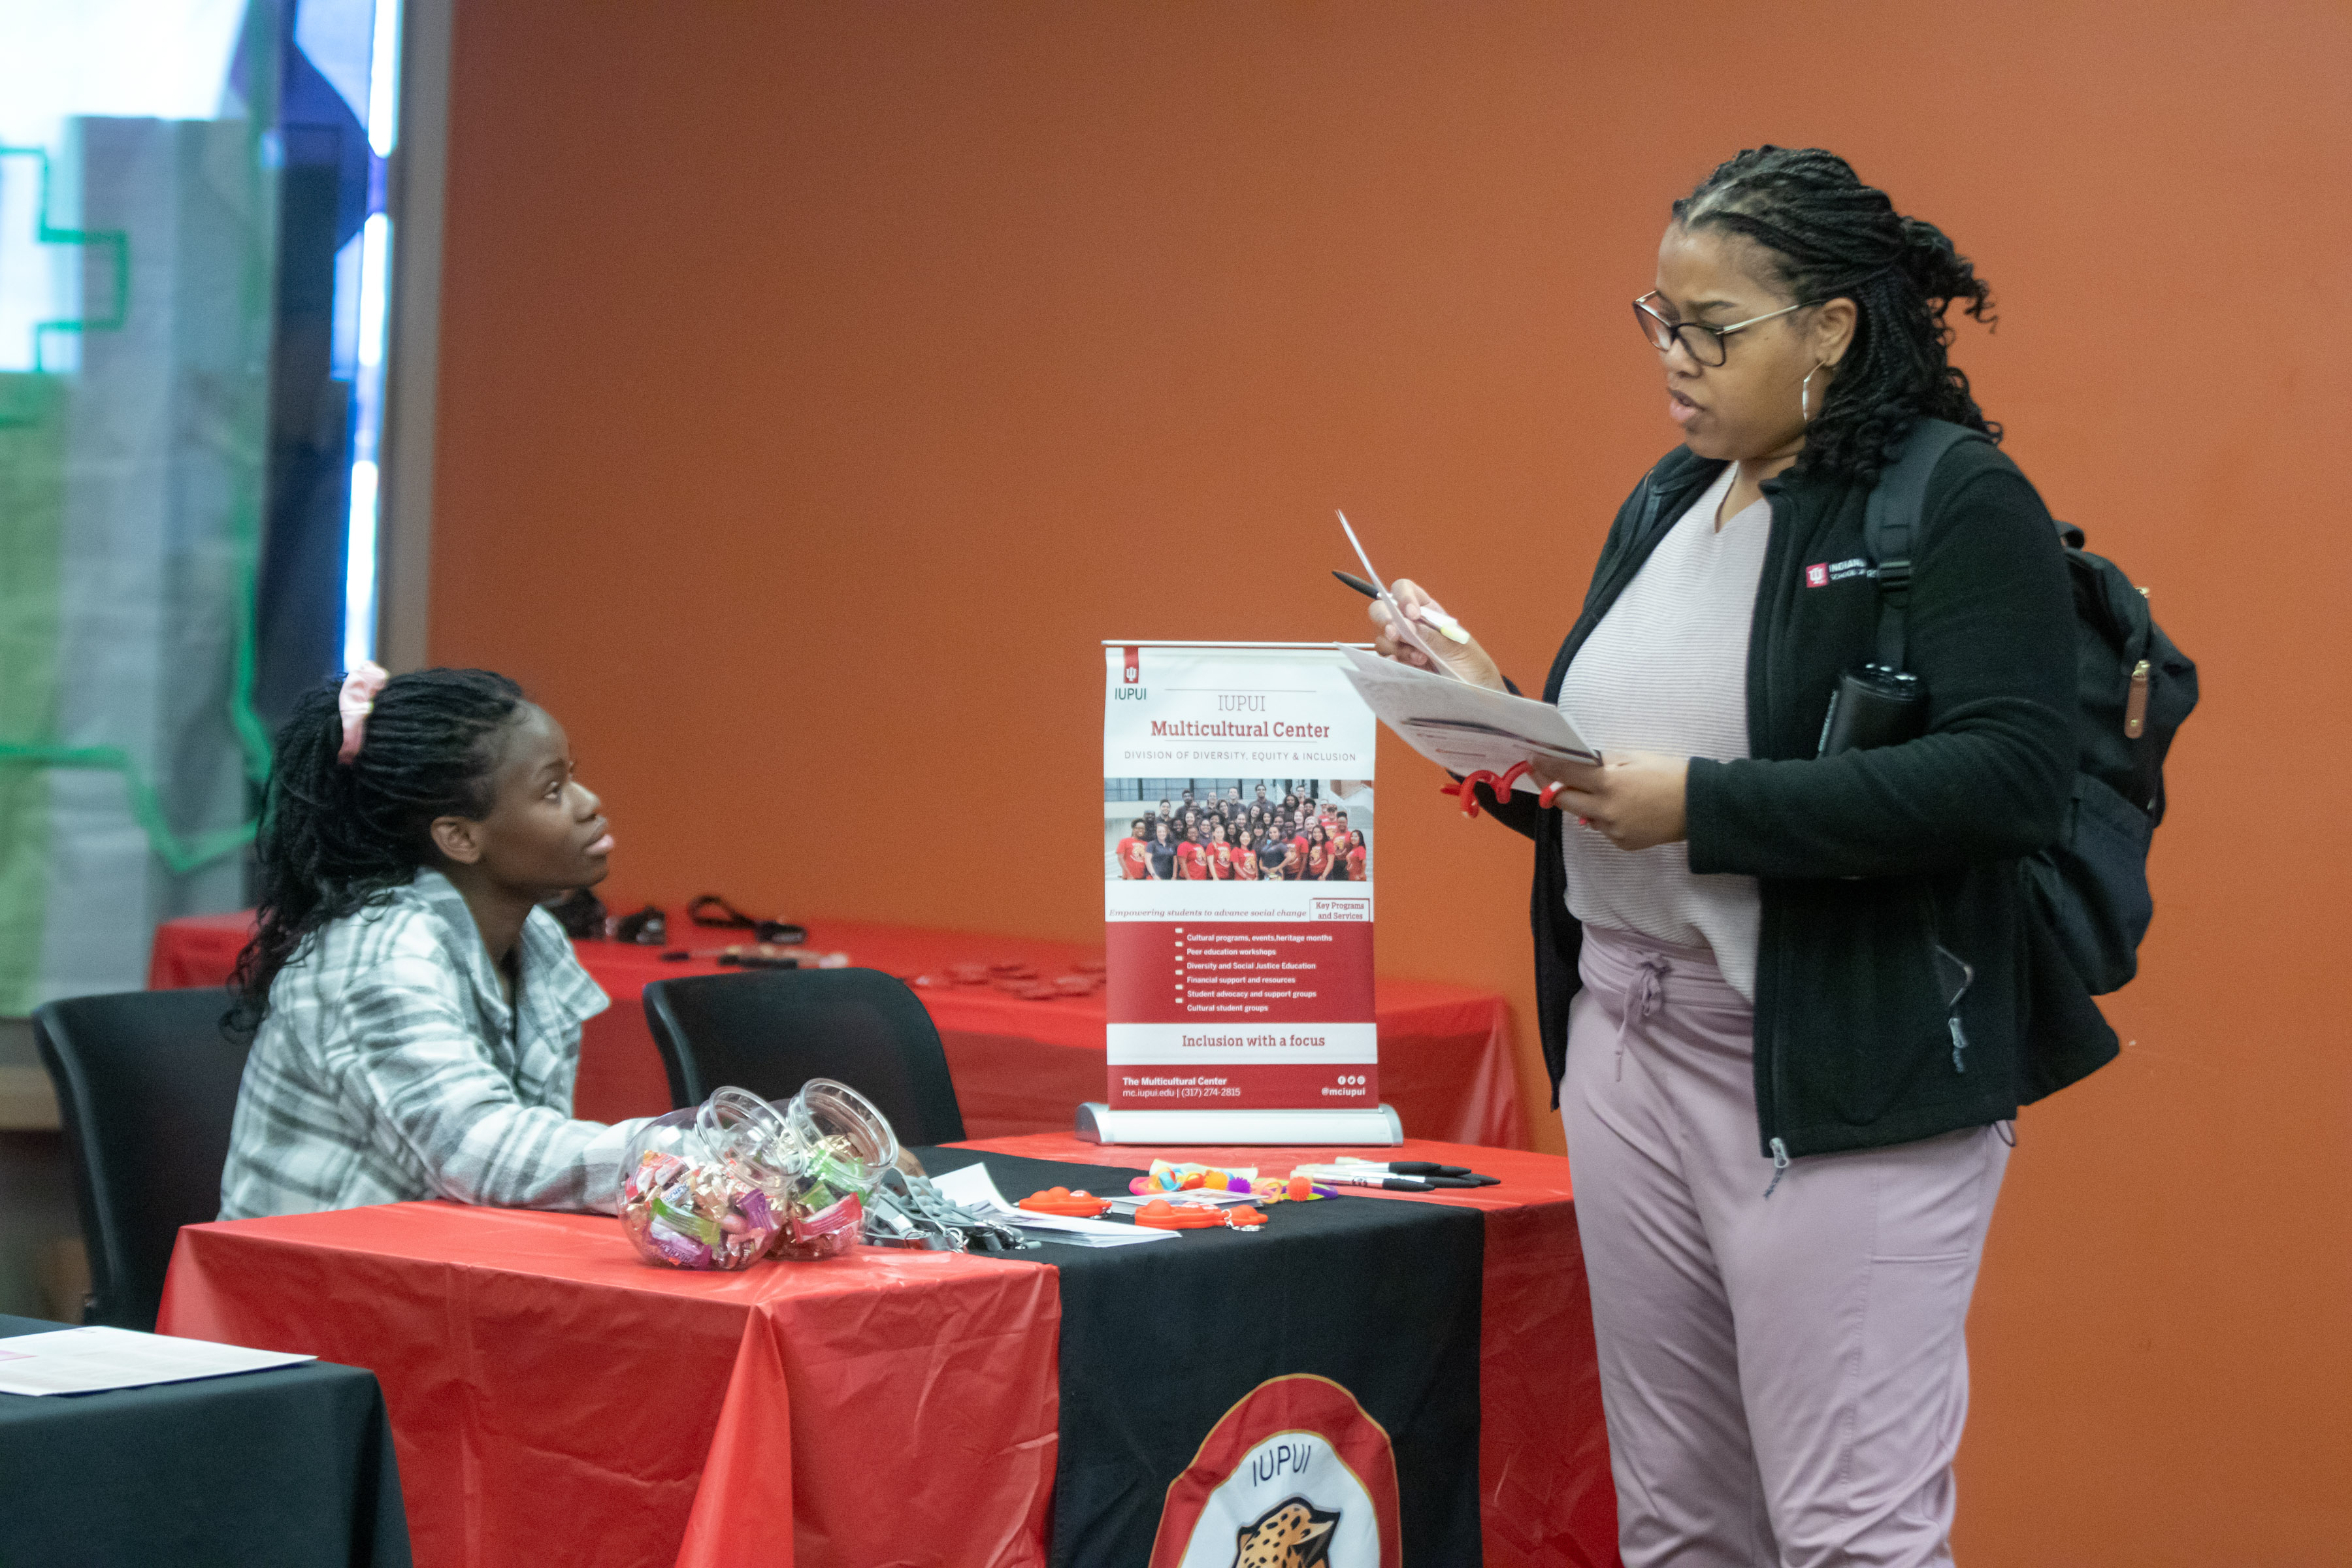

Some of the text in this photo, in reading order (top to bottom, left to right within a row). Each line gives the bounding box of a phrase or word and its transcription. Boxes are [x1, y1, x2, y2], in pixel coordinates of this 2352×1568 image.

[1115, 687, 1147, 700] IUPUI
[1218, 694, 1266, 711] IUPUI
[1151, 720, 1330, 738] Multicultural Center
[1124, 751, 1172, 759] DIVISION
[1193, 751, 1249, 760] DIVERSITY,
[1252, 752, 1289, 761] EQUITY
[1303, 753, 1356, 761] INCLUSION
[1316, 902, 1364, 911] Key Programs
[1109, 909, 1166, 917] Empowering
[1277, 909, 1307, 917] change
[1318, 911, 1332, 920] and
[1239, 948, 1276, 956] workshops
[1181, 1034, 1326, 1047] Inclusion with a focus
[1122, 1077, 1139, 1086] The
[1141, 1077, 1196, 1086] Multicultural
[1122, 1089, 1175, 1098] mc.iupui.edu
[1181, 1088, 1202, 1098] (317)
[1203, 1088, 1241, 1097] 274-2815
[1321, 1087, 1366, 1098] @mciupui
[1252, 1443, 1311, 1487] IUPUI
